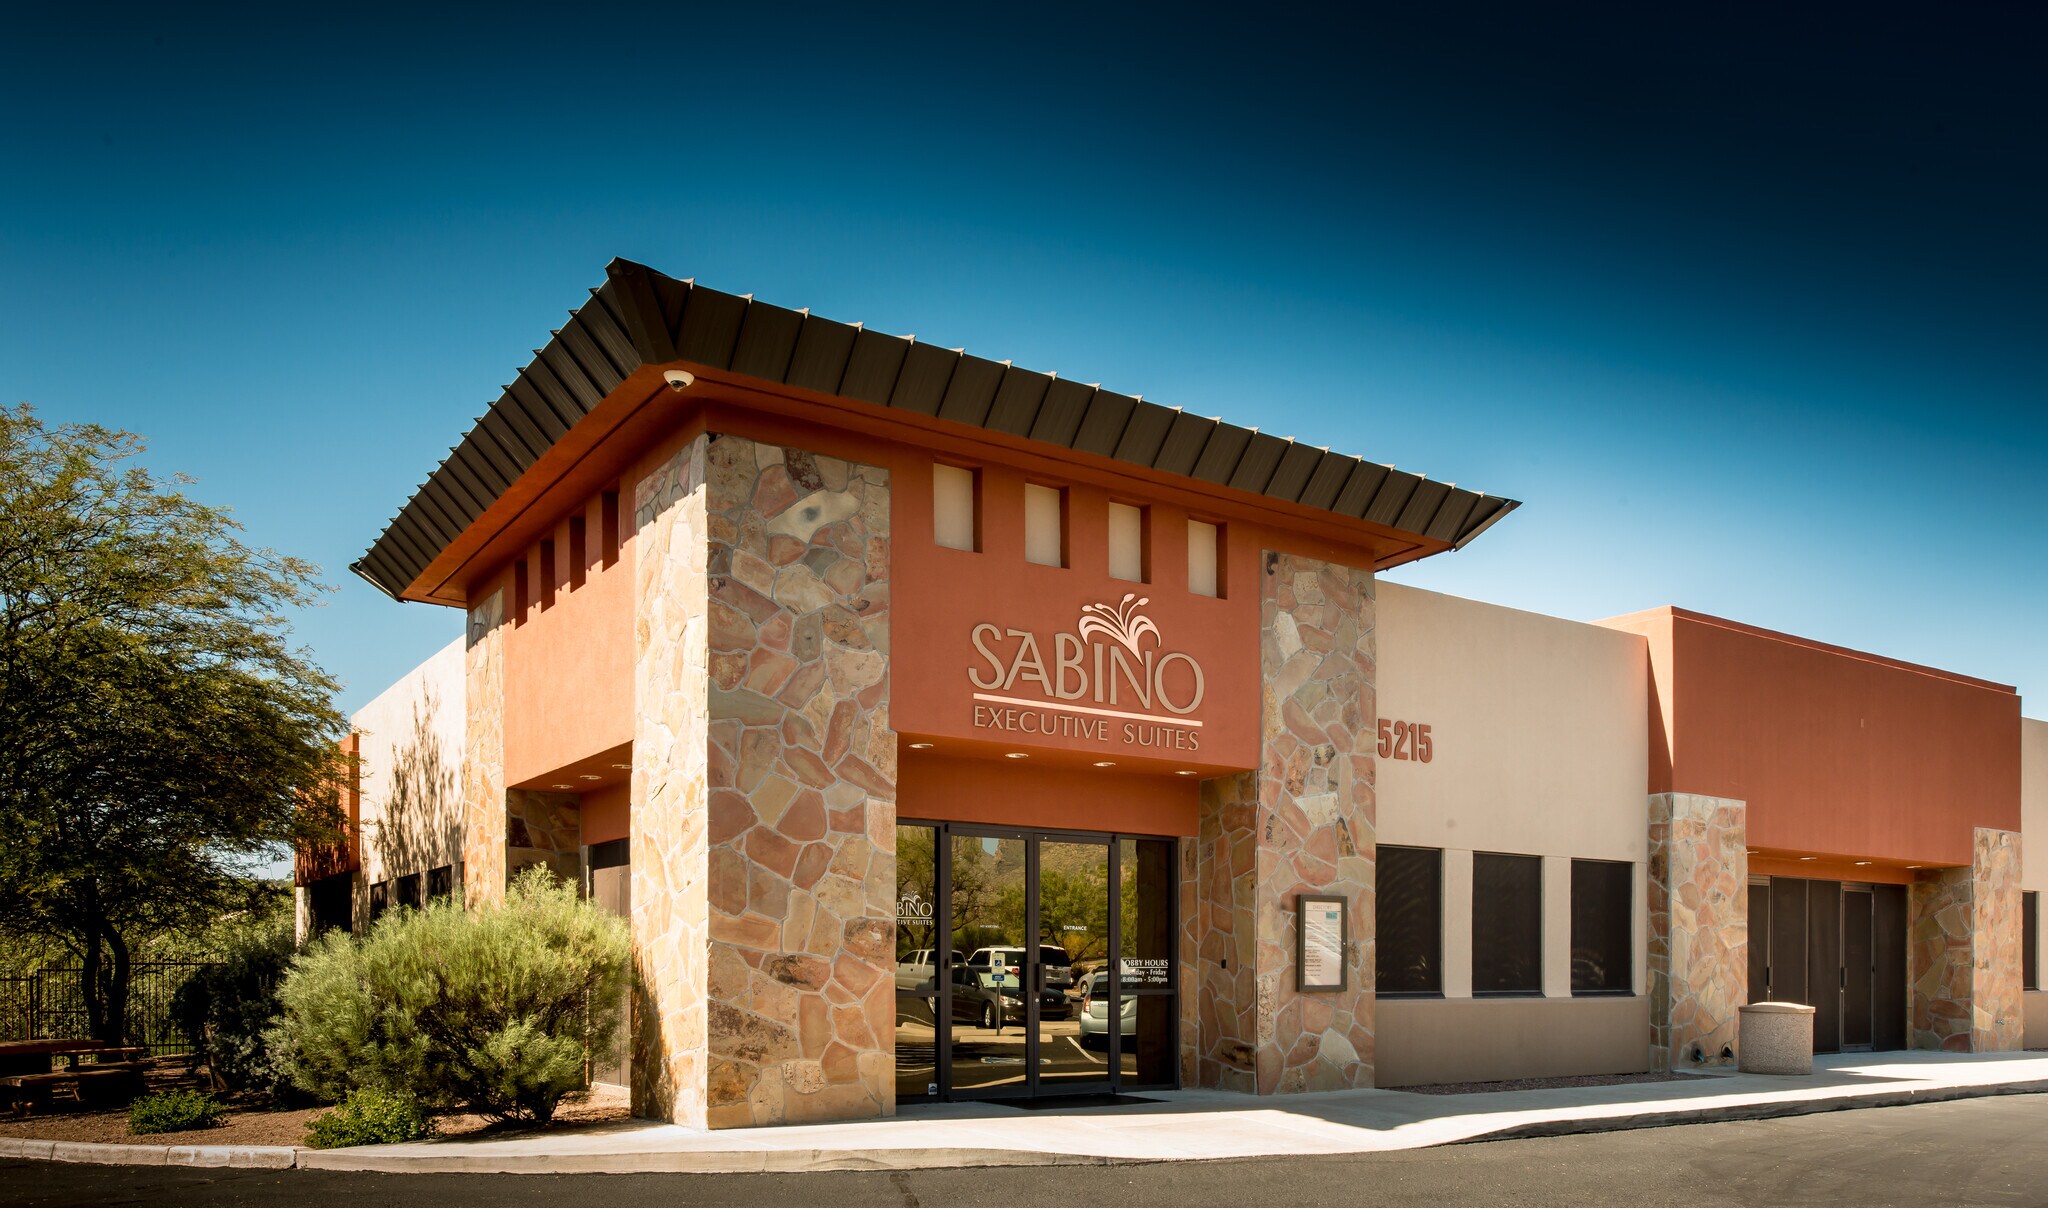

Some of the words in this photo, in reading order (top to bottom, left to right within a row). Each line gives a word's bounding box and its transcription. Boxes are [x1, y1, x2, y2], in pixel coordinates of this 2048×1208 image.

[967, 622, 1206, 715] SABINO
[973, 704, 1109, 742] EXECUTIVE
[1122, 722, 1200, 751] SUITES
[1377, 718, 1433, 764] 5215
[1121, 959, 1144, 967] OBBY
[1144, 959, 1169, 967] HOURS
[1150, 968, 1167, 977] Friday
[1147, 976, 1168, 984] 5:00pm
